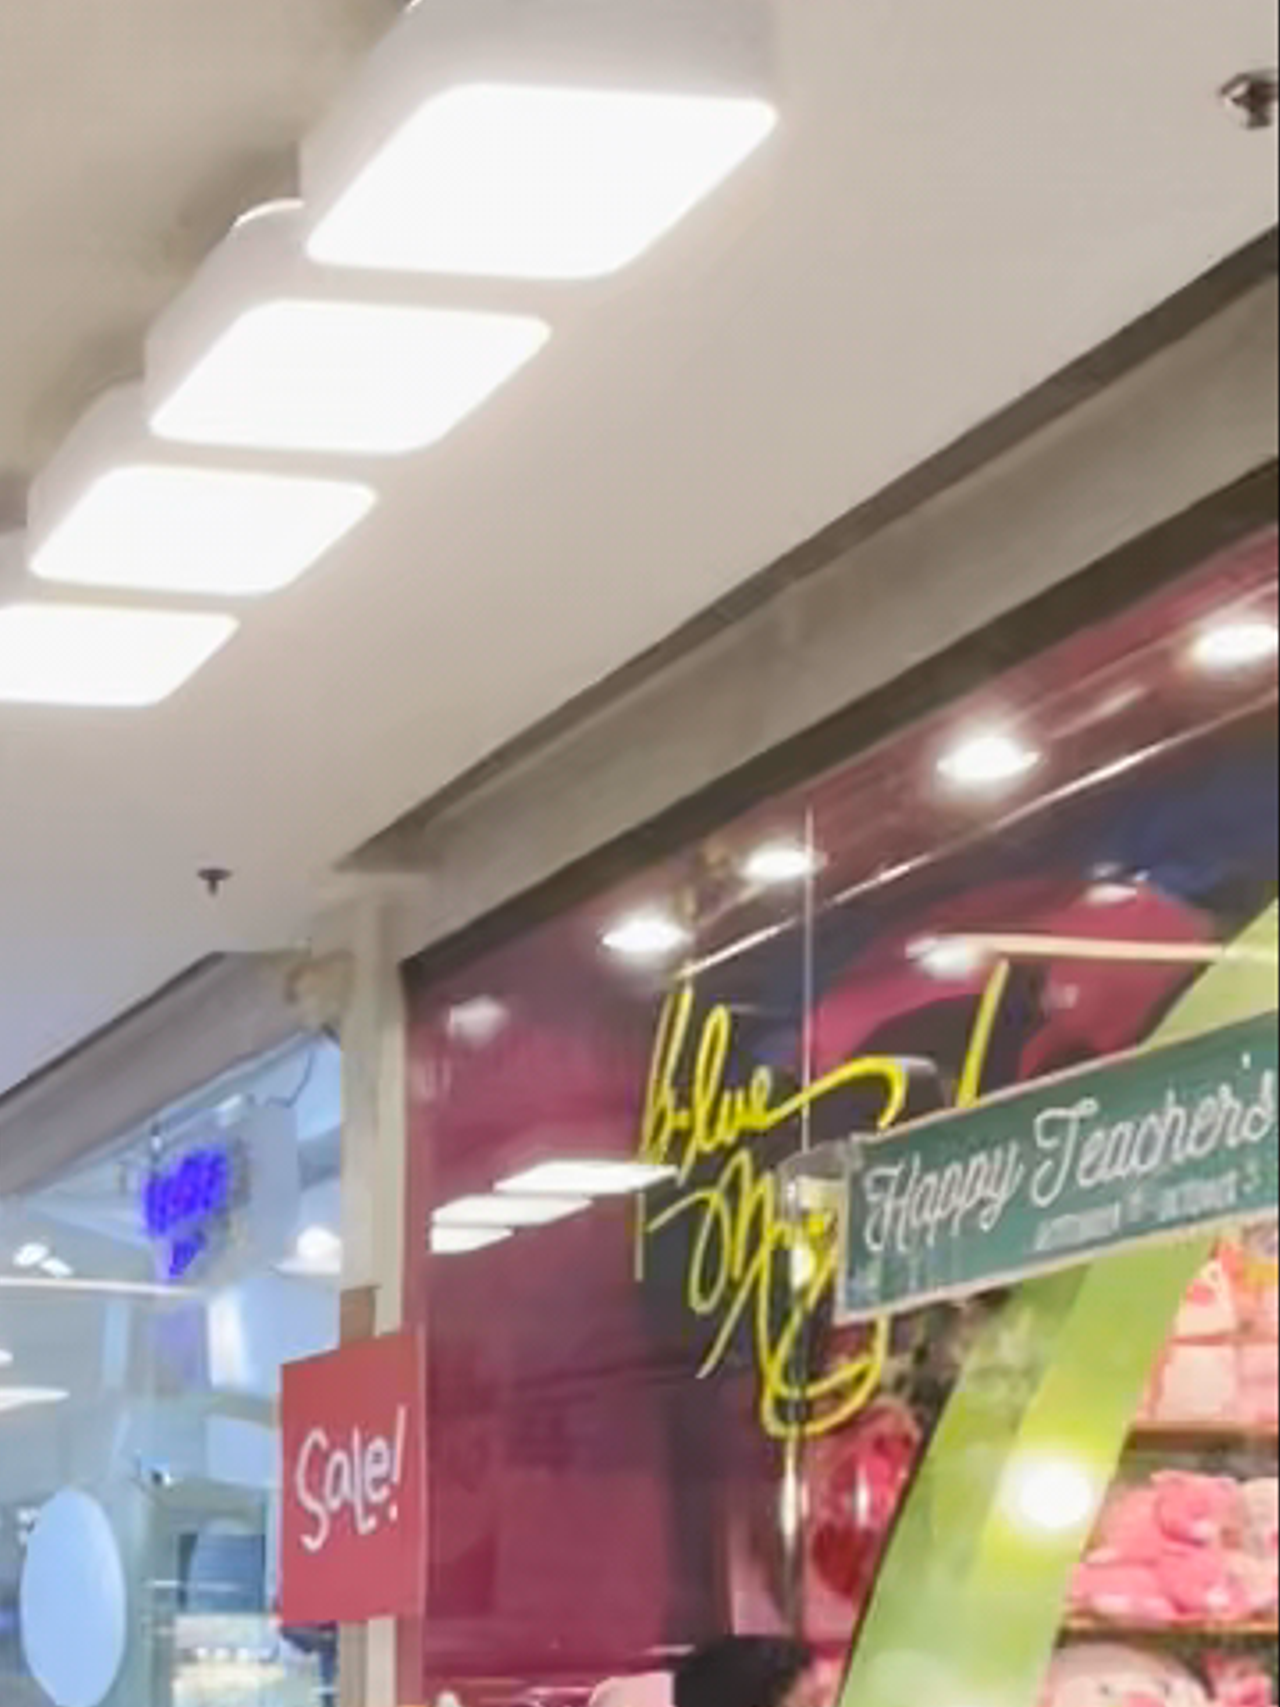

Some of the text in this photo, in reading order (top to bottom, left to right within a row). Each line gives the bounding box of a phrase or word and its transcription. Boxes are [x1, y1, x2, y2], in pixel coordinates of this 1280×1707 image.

[864, 1140, 1026, 1253] Happy
[1030, 1052, 1276, 1208] Teacher's
[296, 1404, 406, 1552] Sale!
